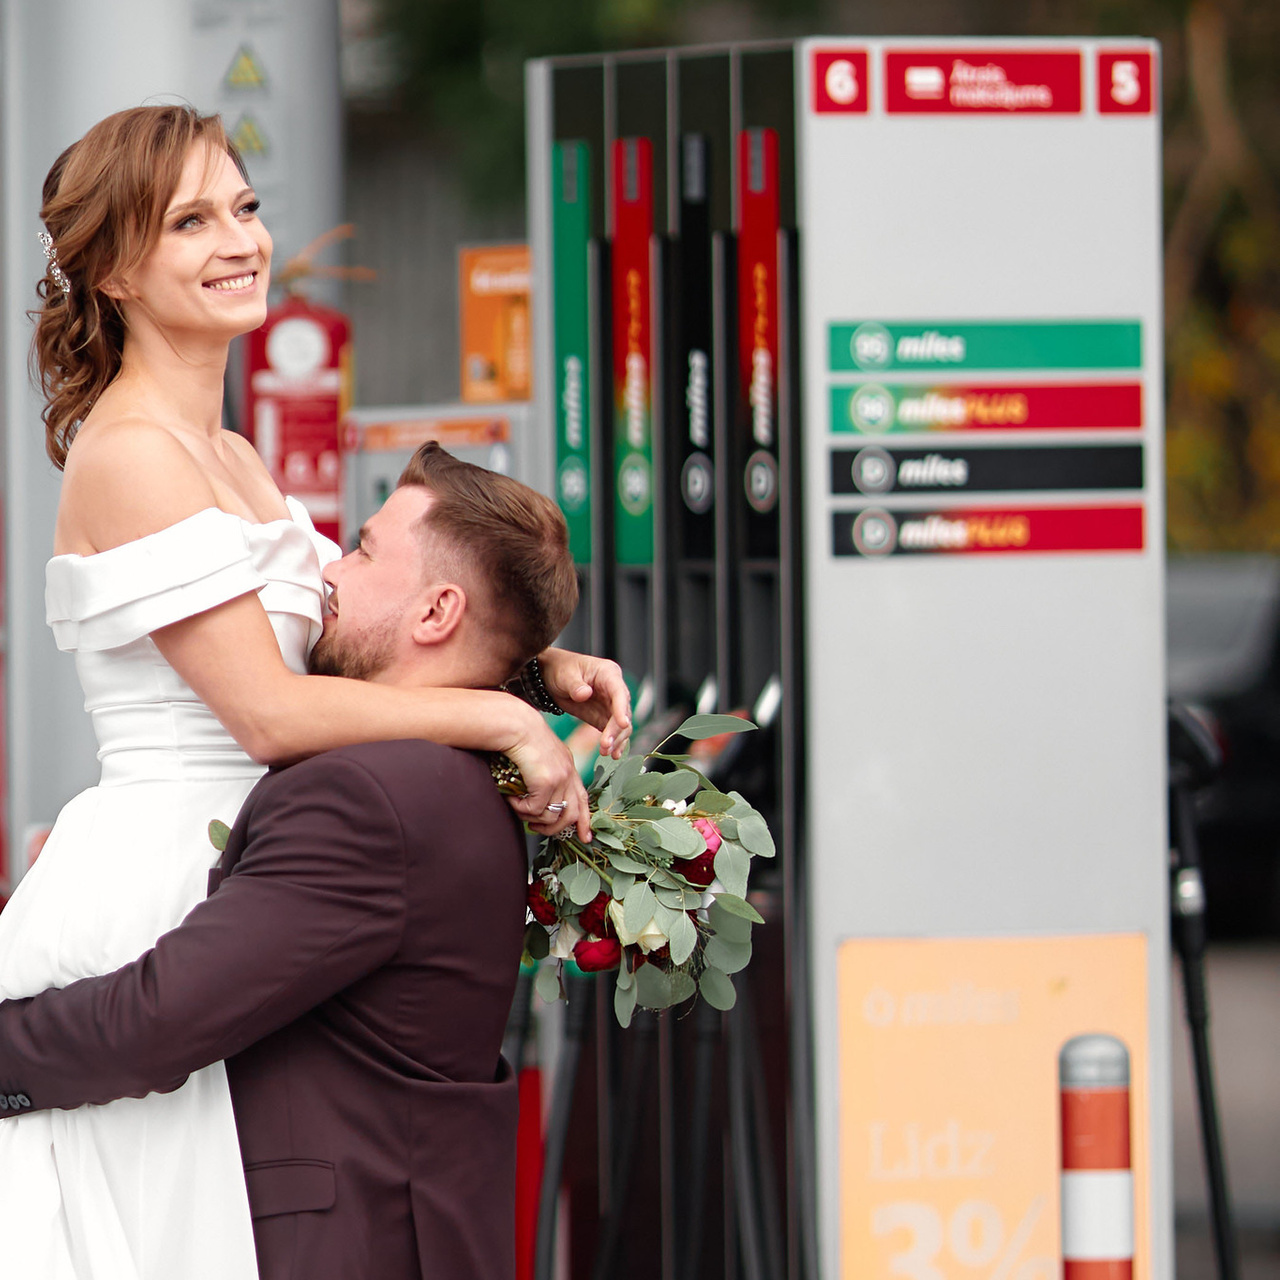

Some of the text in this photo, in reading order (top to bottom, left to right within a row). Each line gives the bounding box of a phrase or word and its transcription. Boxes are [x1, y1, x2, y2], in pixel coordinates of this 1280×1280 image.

[825, 60, 859, 105] 6
[1111, 61, 1141, 105] 5
[896, 331, 966, 362] miles
[563, 354, 582, 449] miles
[686, 349, 708, 448] miles
[898, 454, 968, 486] miles
[901, 980, 1020, 1026] miles
